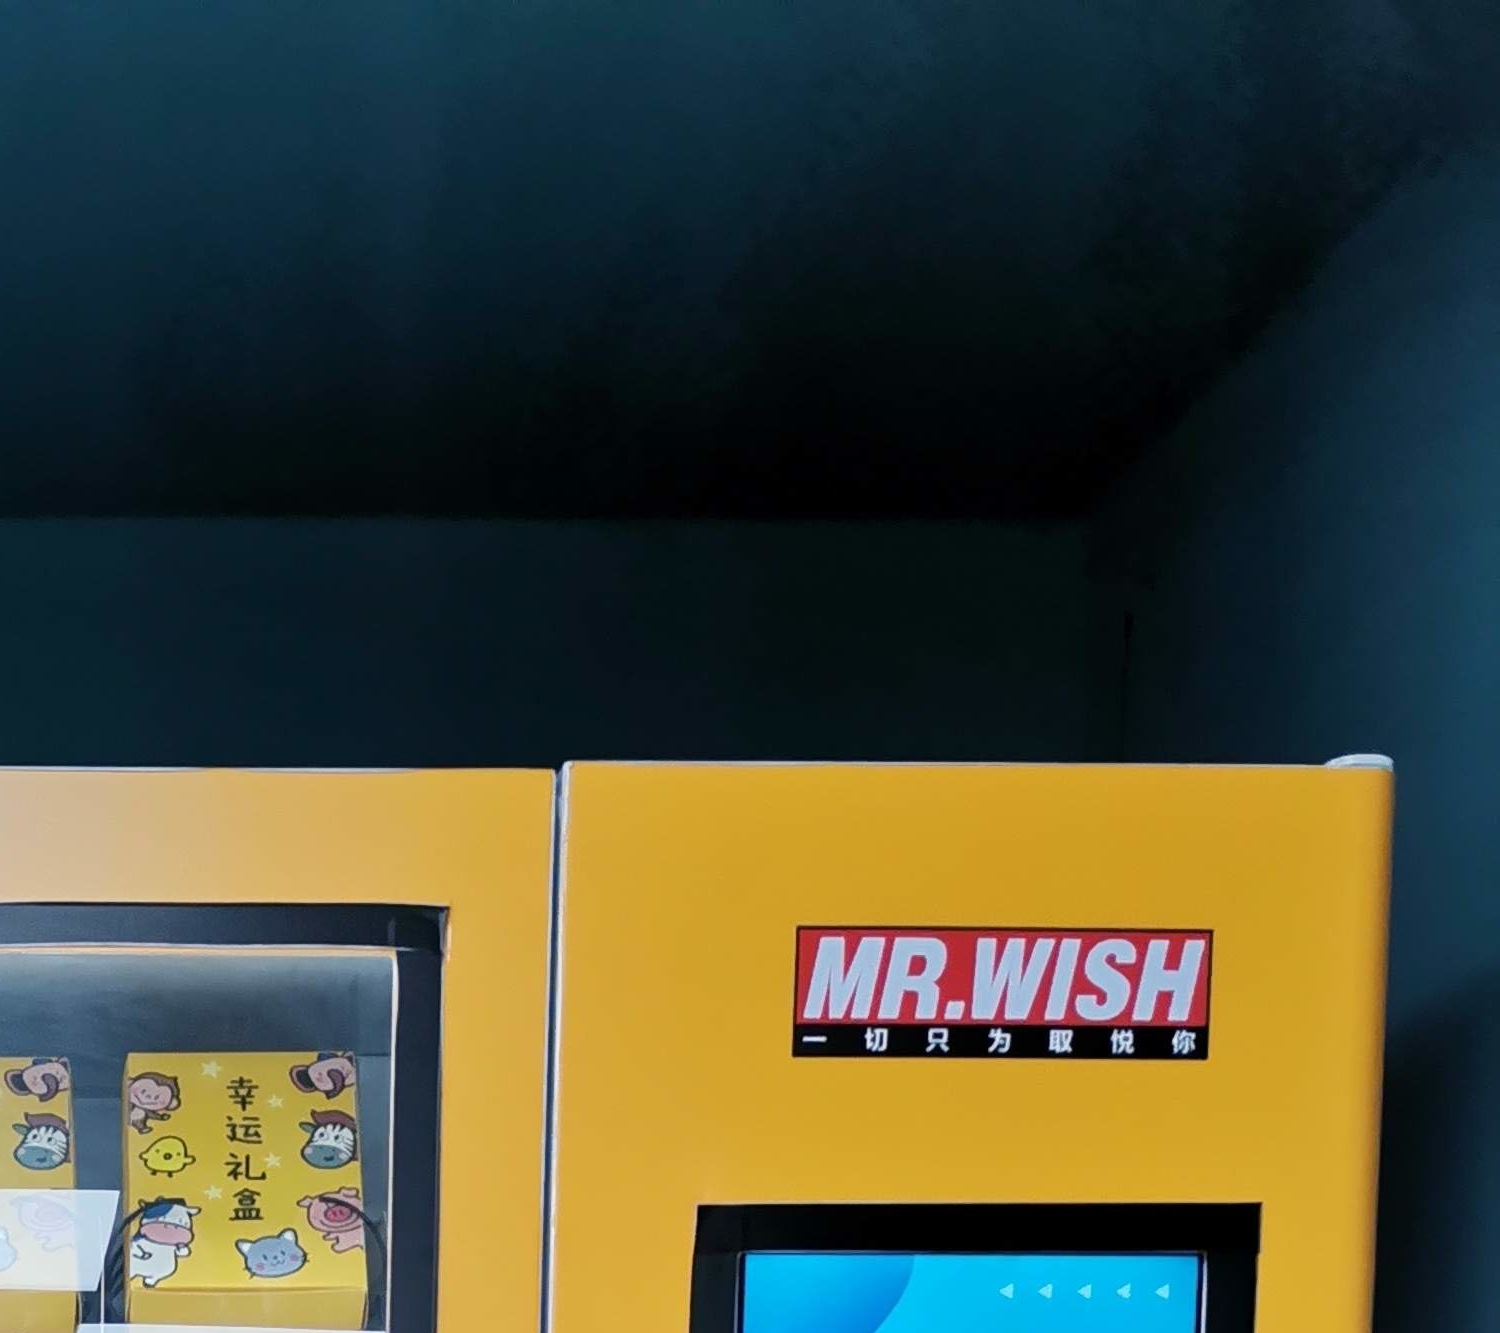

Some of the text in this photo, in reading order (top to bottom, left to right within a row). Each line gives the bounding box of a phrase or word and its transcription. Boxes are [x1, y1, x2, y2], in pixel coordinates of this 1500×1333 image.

[803, 936, 1205, 1022] MR.WISH
[802, 1027, 1197, 1054] 一切只为取悦你
[224, 1075, 266, 1222] 幸运礼盒
